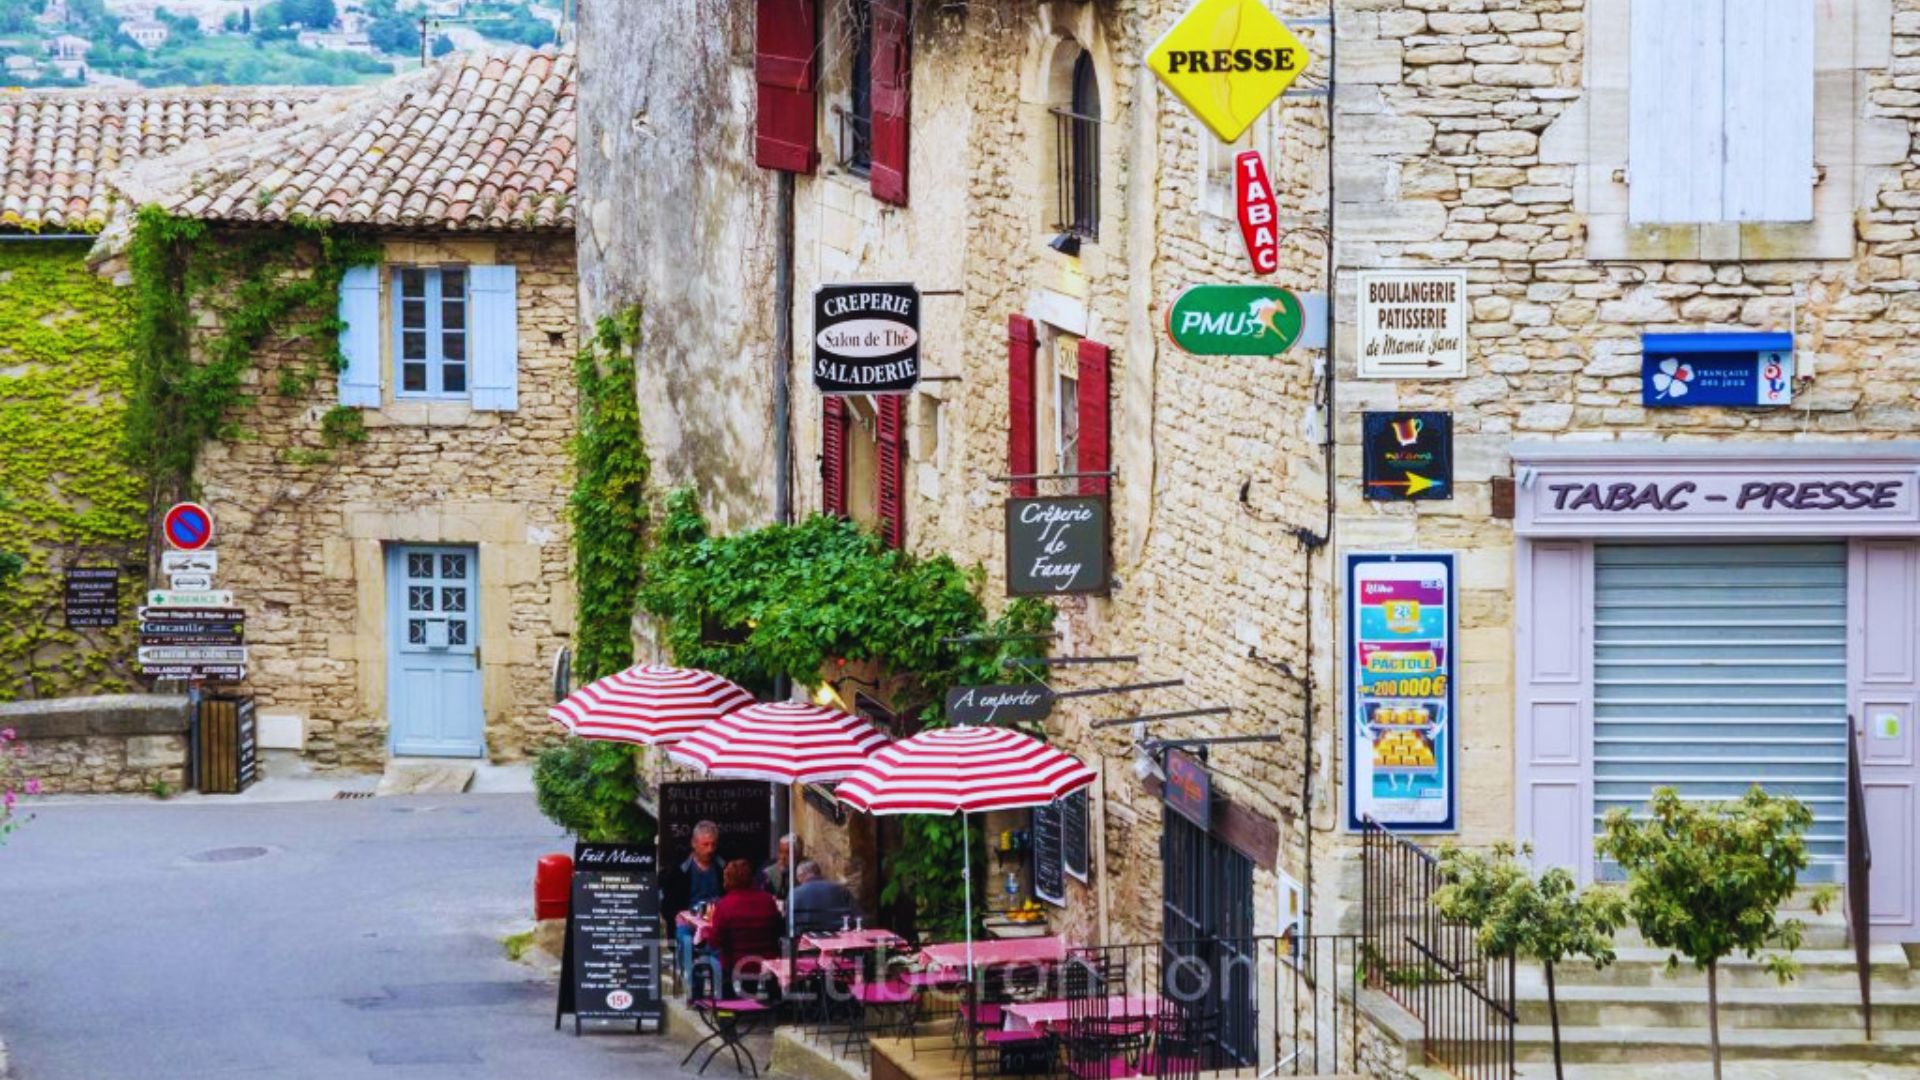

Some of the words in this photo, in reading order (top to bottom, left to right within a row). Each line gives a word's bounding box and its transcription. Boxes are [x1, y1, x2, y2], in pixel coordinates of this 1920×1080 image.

[1168, 48, 1295, 74] PRESSE
[1243, 158, 1277, 269] TABAC
[823, 292, 913, 317] CREPERIE
[1369, 282, 1457, 304] BOULANGERIE
[1180, 311, 1248, 336] PMU
[1378, 308, 1448, 330] PATISSERIE
[825, 332, 860, 348] Salon
[863, 331, 881, 347] de
[883, 328, 909, 347] Thé
[1366, 336, 1381, 357] de
[1382, 333, 1426, 356] Mamie
[815, 358, 916, 384] SALADERIE
[1549, 482, 1697, 512] TABAC
[1735, 481, 1903, 511] PRESSE
[1020, 503, 1094, 541] Crêperie
[1044, 523, 1071, 555] de
[1029, 556, 1082, 591] Fanny
[953, 688, 976, 710] A
[980, 690, 1042, 722] emporter
[579, 848, 606, 862] Fait
[605, 849, 653, 864] Maison
